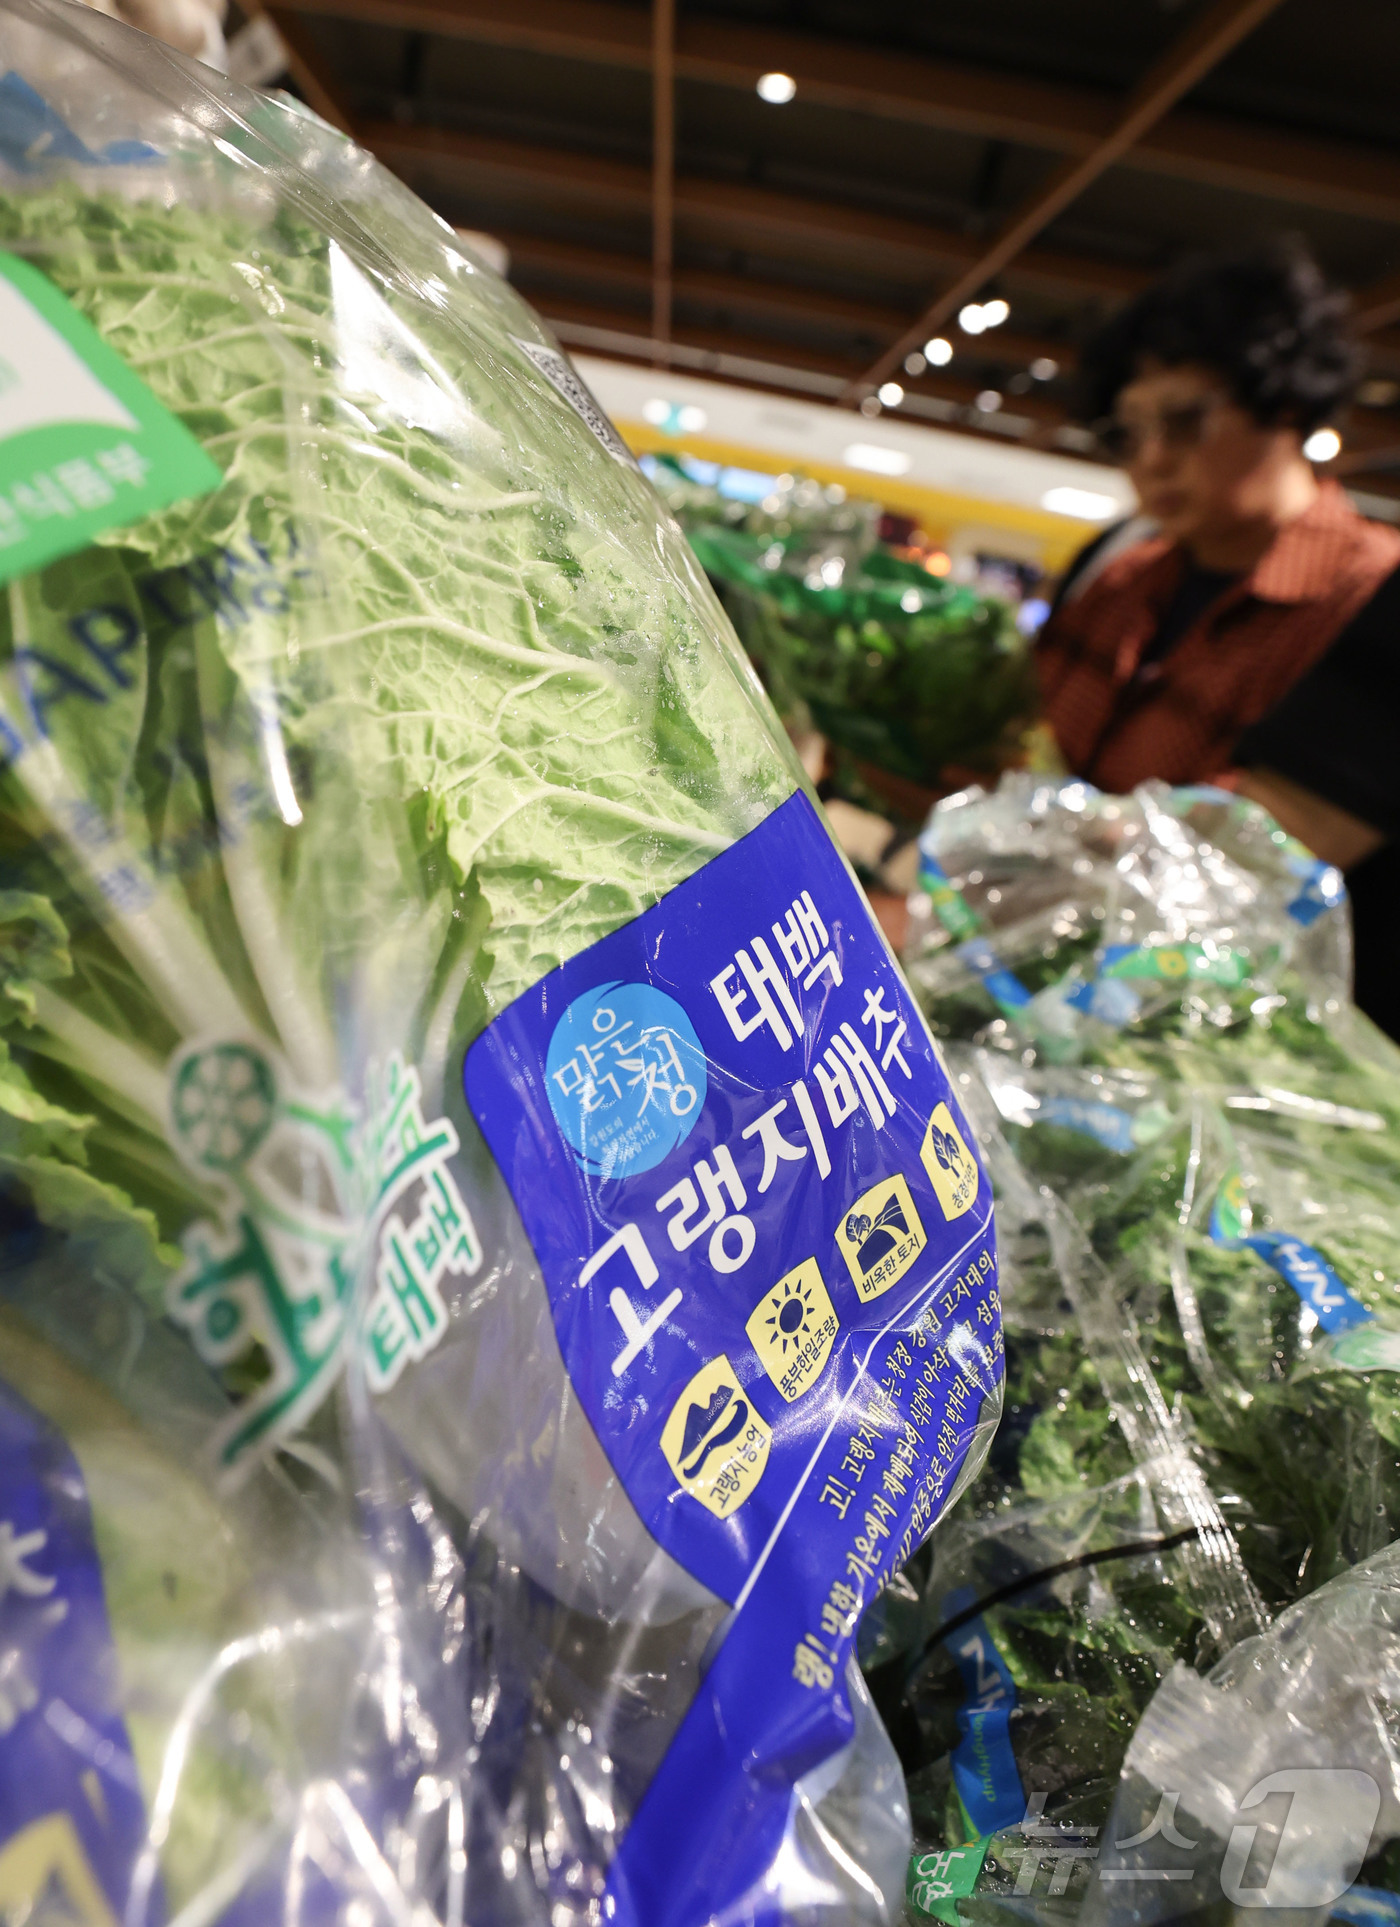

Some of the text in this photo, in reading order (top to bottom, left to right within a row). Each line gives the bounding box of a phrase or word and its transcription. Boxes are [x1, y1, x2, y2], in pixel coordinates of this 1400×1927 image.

[709, 890, 843, 1052] 태백
[578, 986, 913, 1378] 고랭지배추
[951, 1161, 979, 1210] 청정자연
[862, 1232, 922, 1294] 비옥한 토지
[779, 1315, 837, 1398] 풍부한일조량
[818, 1475, 857, 1520] 고!
[886, 1341, 913, 1379] 청정
[908, 1308, 943, 1348] 강원
[939, 1249, 995, 1319] 고지대의
[945, 1364, 984, 1425] 먹거리를
[709, 1423, 766, 1510] 고랭지 농업
[937, 1419, 961, 1462] 안전
[792, 1633, 838, 1689] 랭!
[846, 1493, 898, 1585] 기온에서
[883, 1420, 925, 1497] 재배되어
[910, 1378, 936, 1426] 식감이
